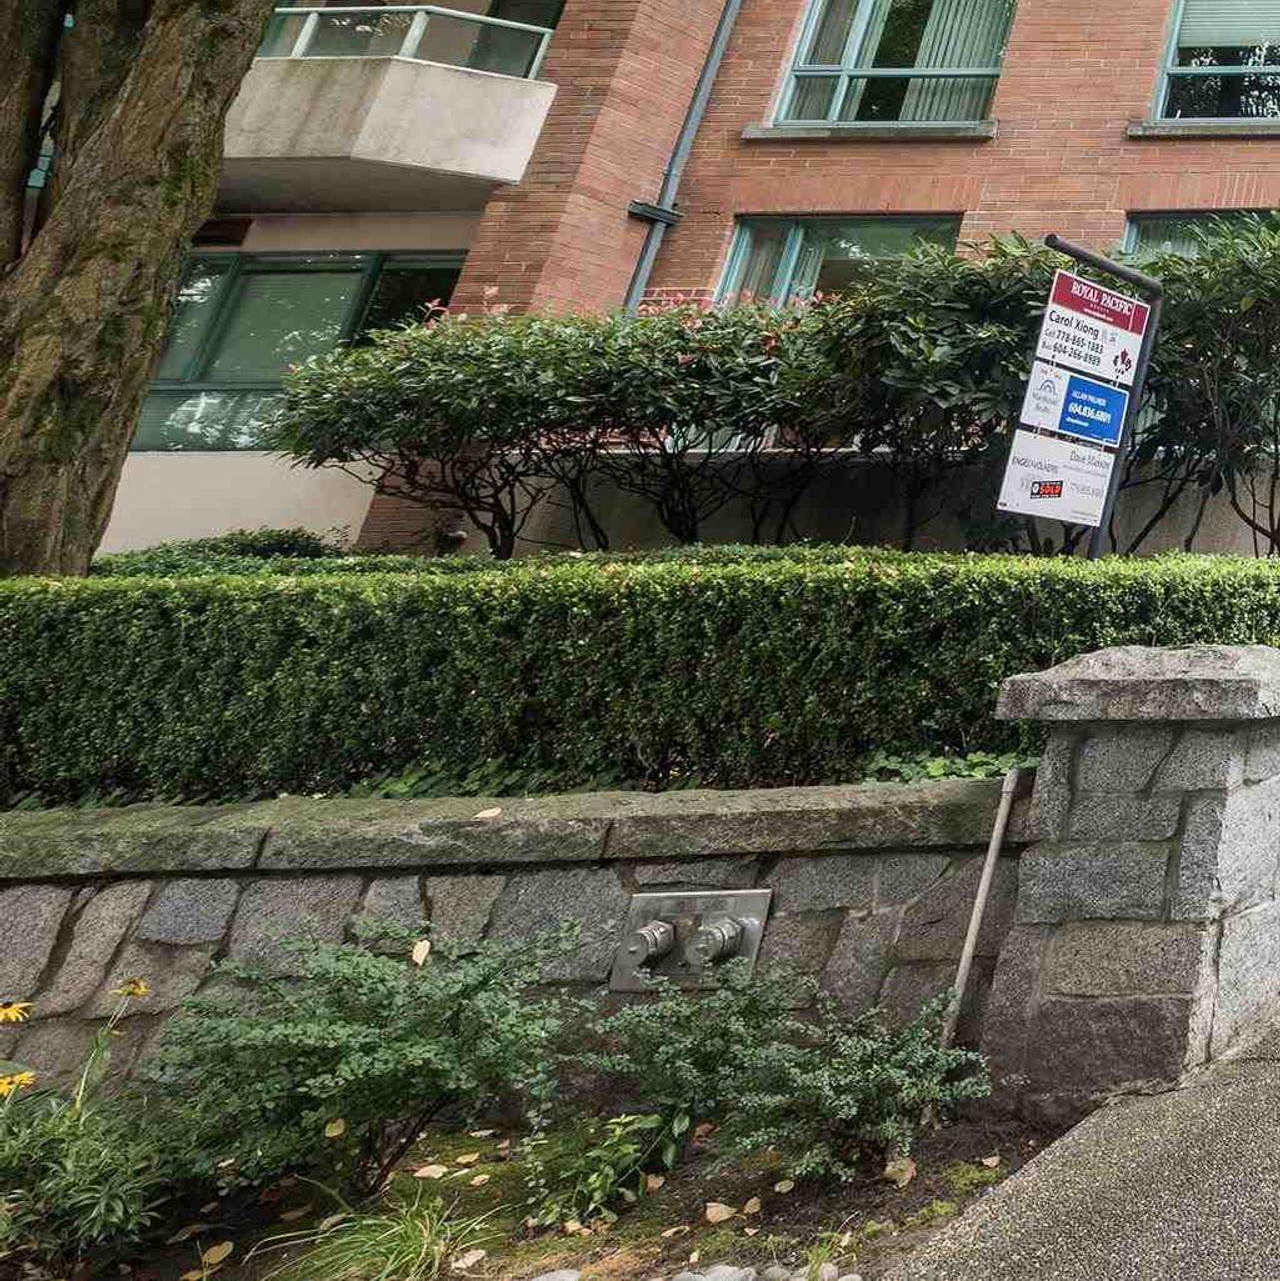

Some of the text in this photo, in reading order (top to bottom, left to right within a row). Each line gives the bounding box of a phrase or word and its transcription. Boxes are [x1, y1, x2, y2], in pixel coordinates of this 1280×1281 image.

[1071, 280, 1099, 302] ROYAL
[1100, 292, 1132, 316] PACIFIC
[1049, 310, 1073, 327] Carol
[1075, 318, 1099, 340] Xiong
[1040, 484, 1061, 495] SOLD
